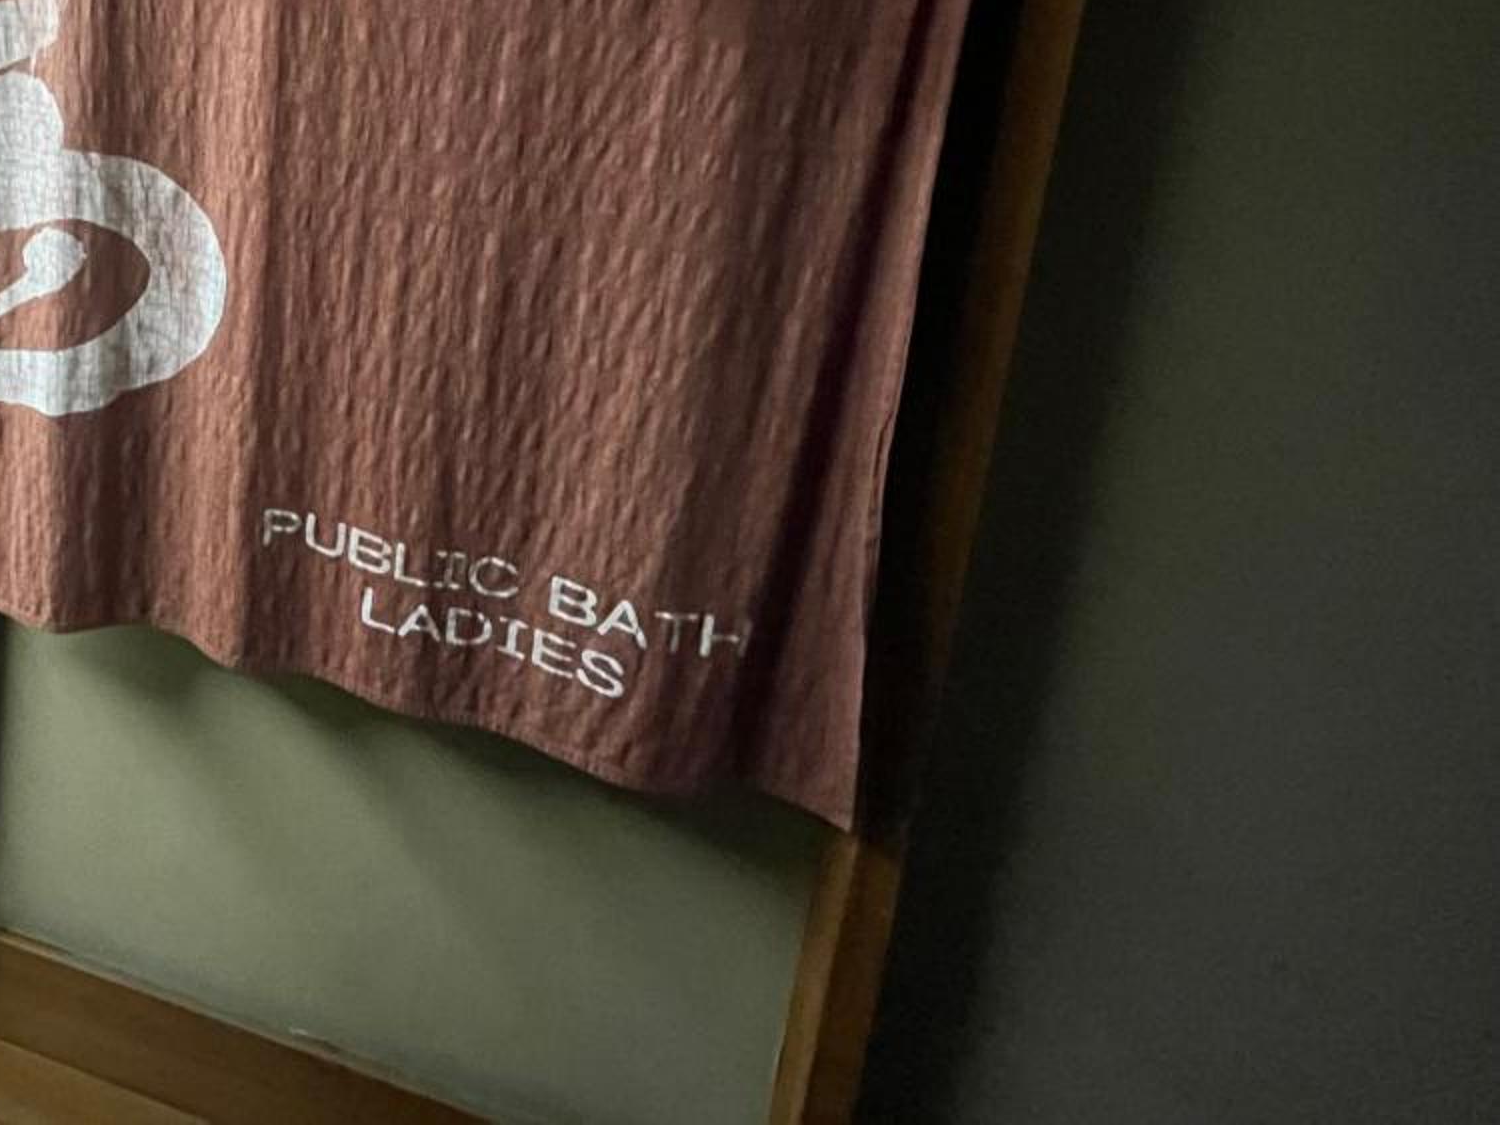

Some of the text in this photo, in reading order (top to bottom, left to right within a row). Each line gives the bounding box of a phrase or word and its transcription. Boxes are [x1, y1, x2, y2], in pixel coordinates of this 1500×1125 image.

[261, 507, 750, 659] PUBLIC BATH
[359, 586, 626, 700] LADIES
